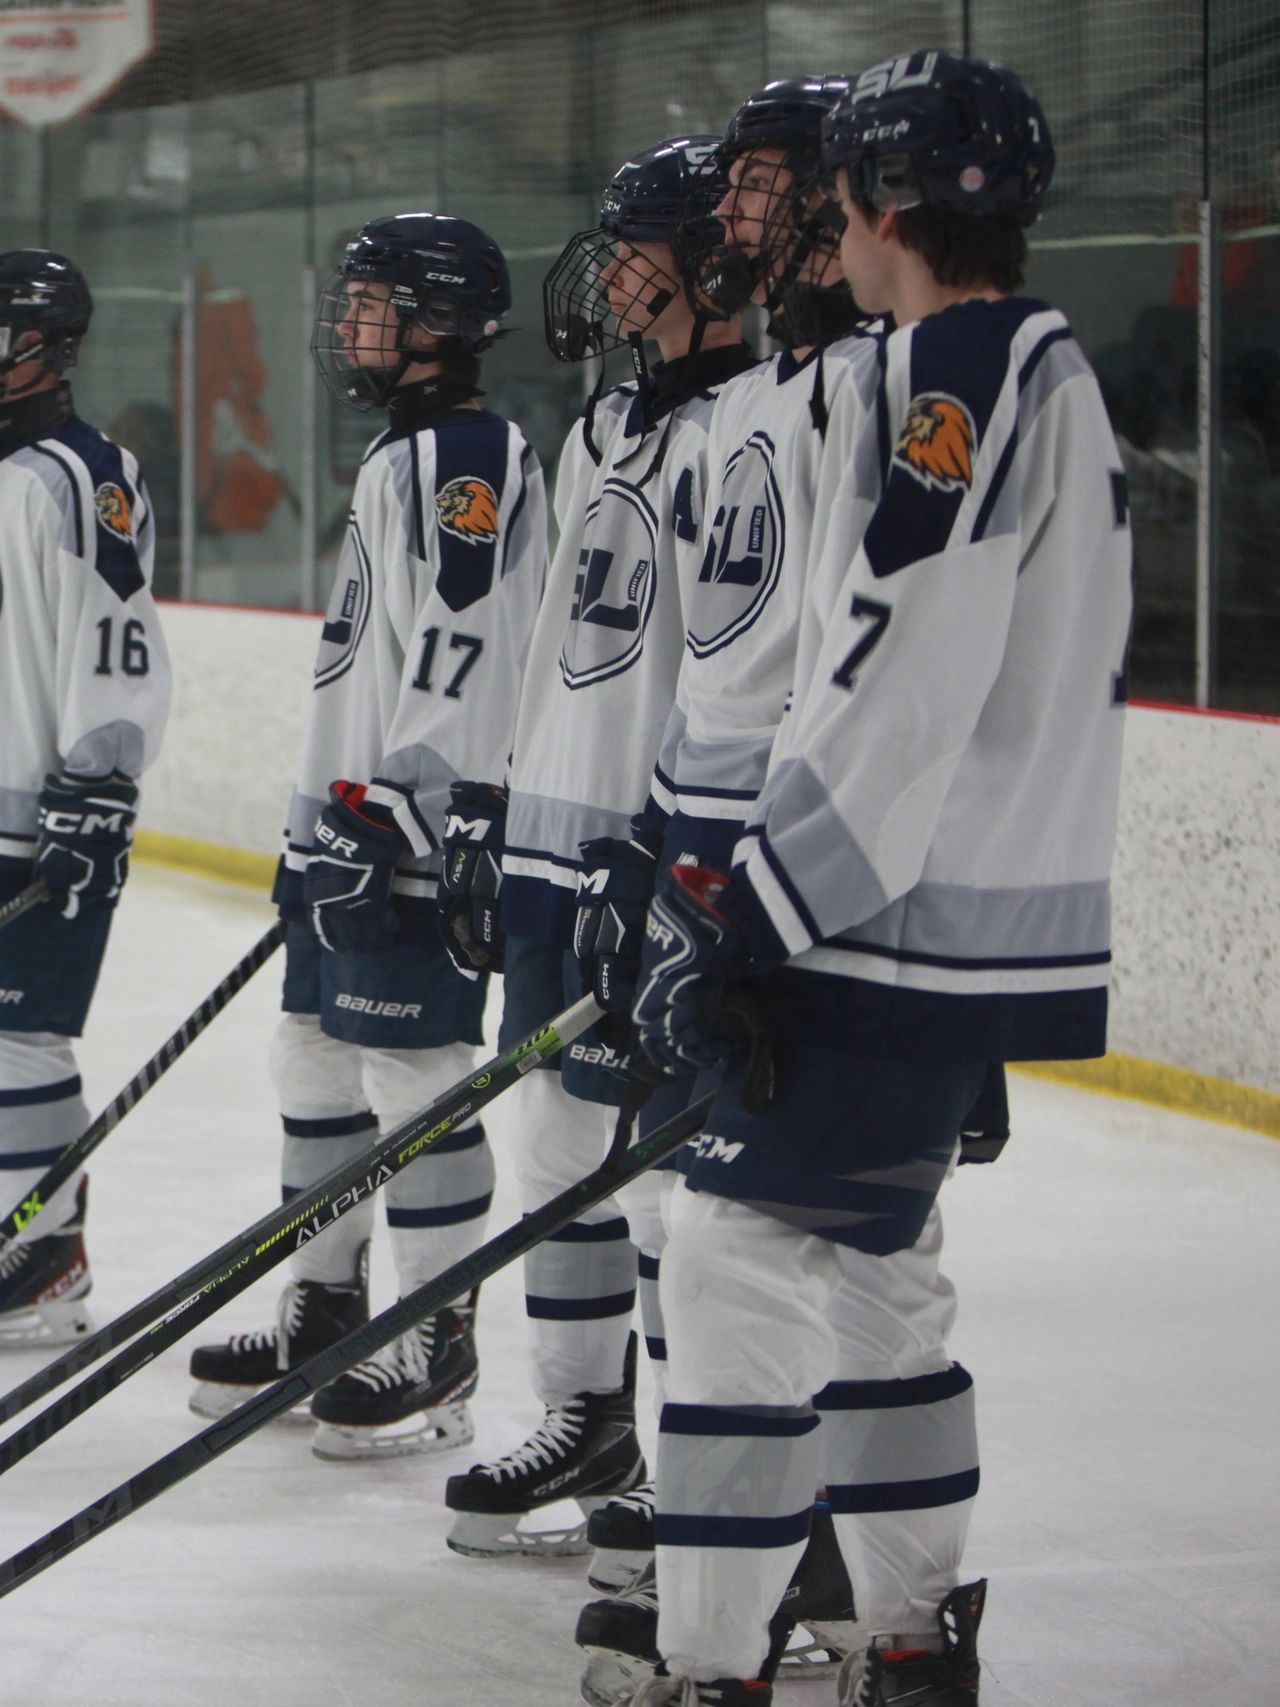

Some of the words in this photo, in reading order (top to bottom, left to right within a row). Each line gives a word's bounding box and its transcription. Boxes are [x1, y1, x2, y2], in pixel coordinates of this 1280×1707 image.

[426, 271, 466, 285] CCM
[390, 297, 419, 308] CCM
[751, 508, 763, 549] UNIFIED
[94, 616, 150, 678] 16
[412, 625, 484, 699] 17
[830, 592, 893, 693] 7
[483, 908, 492, 942] CCM
[334, 992, 423, 1020] BAUER
[295, 1163, 395, 1249] ALPHA
[398, 1115, 452, 1164] FORCE
[13, 1189, 45, 1233] LX
[533, 1466, 580, 1496] CCM
